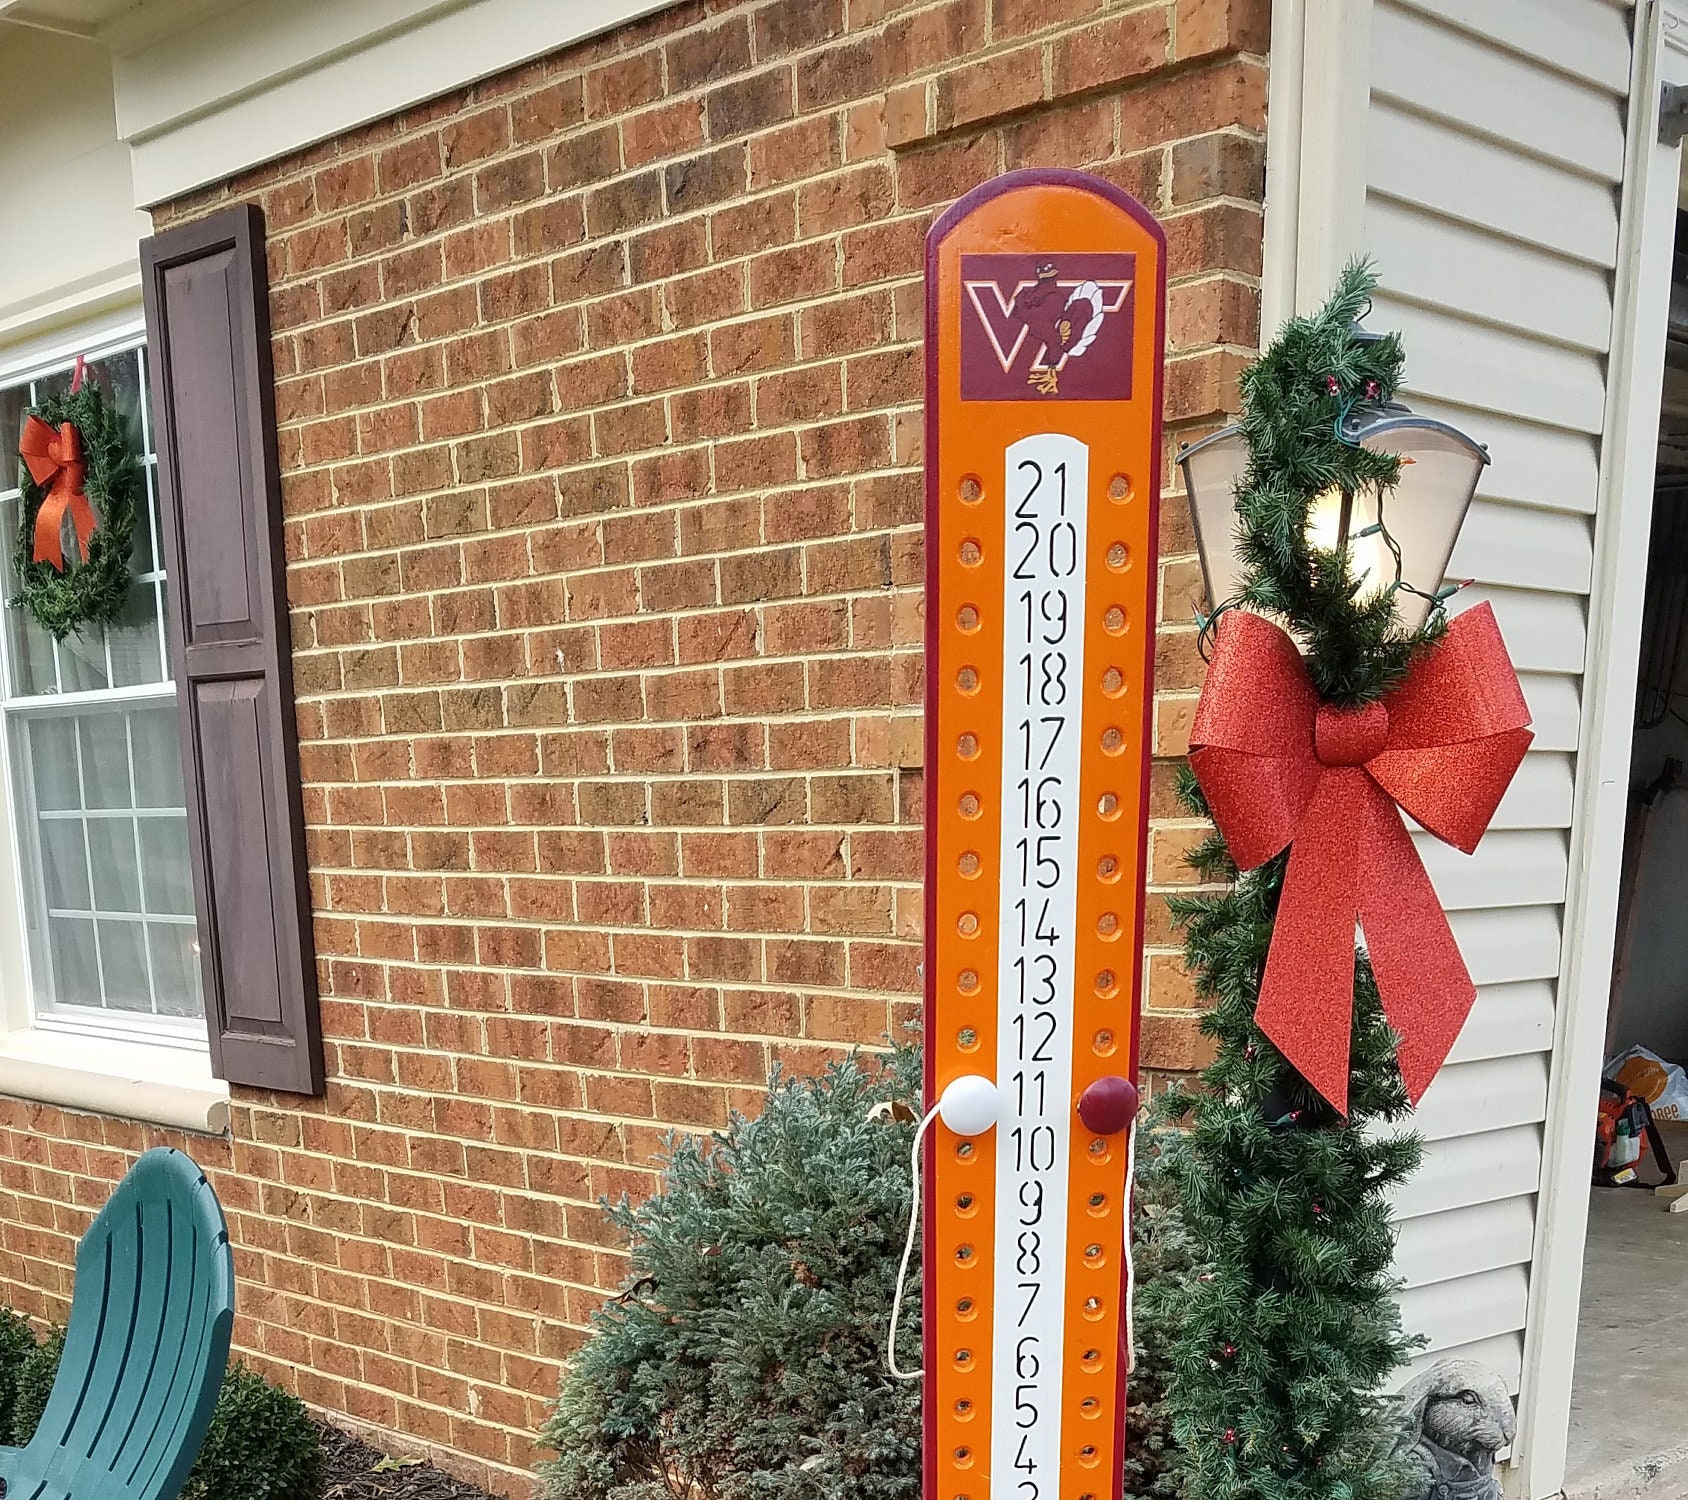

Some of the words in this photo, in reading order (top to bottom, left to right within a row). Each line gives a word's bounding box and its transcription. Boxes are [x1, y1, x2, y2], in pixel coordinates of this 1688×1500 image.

[1014, 460, 1066, 519] 21
[1012, 521, 1077, 580] 20
[1019, 589, 1067, 645] 19
[1019, 651, 1067, 706] 18
[1019, 716, 1066, 771] 17
[1017, 776, 1062, 829] 16
[1016, 835, 1062, 889] 15
[1014, 897, 1061, 947] 14
[1013, 954, 1057, 1006] 13
[1012, 1011, 1057, 1062] 12
[1012, 1070, 1045, 1117] 11
[1010, 1125, 1055, 1172] 10
[1019, 1179, 1043, 1226] 9
[1016, 1231, 1041, 1275] 8
[1017, 1282, 1041, 1328] 7
[1016, 1336, 1040, 1380] 6
[1015, 1384, 1039, 1429] 5
[1013, 1434, 1038, 1475] 4
